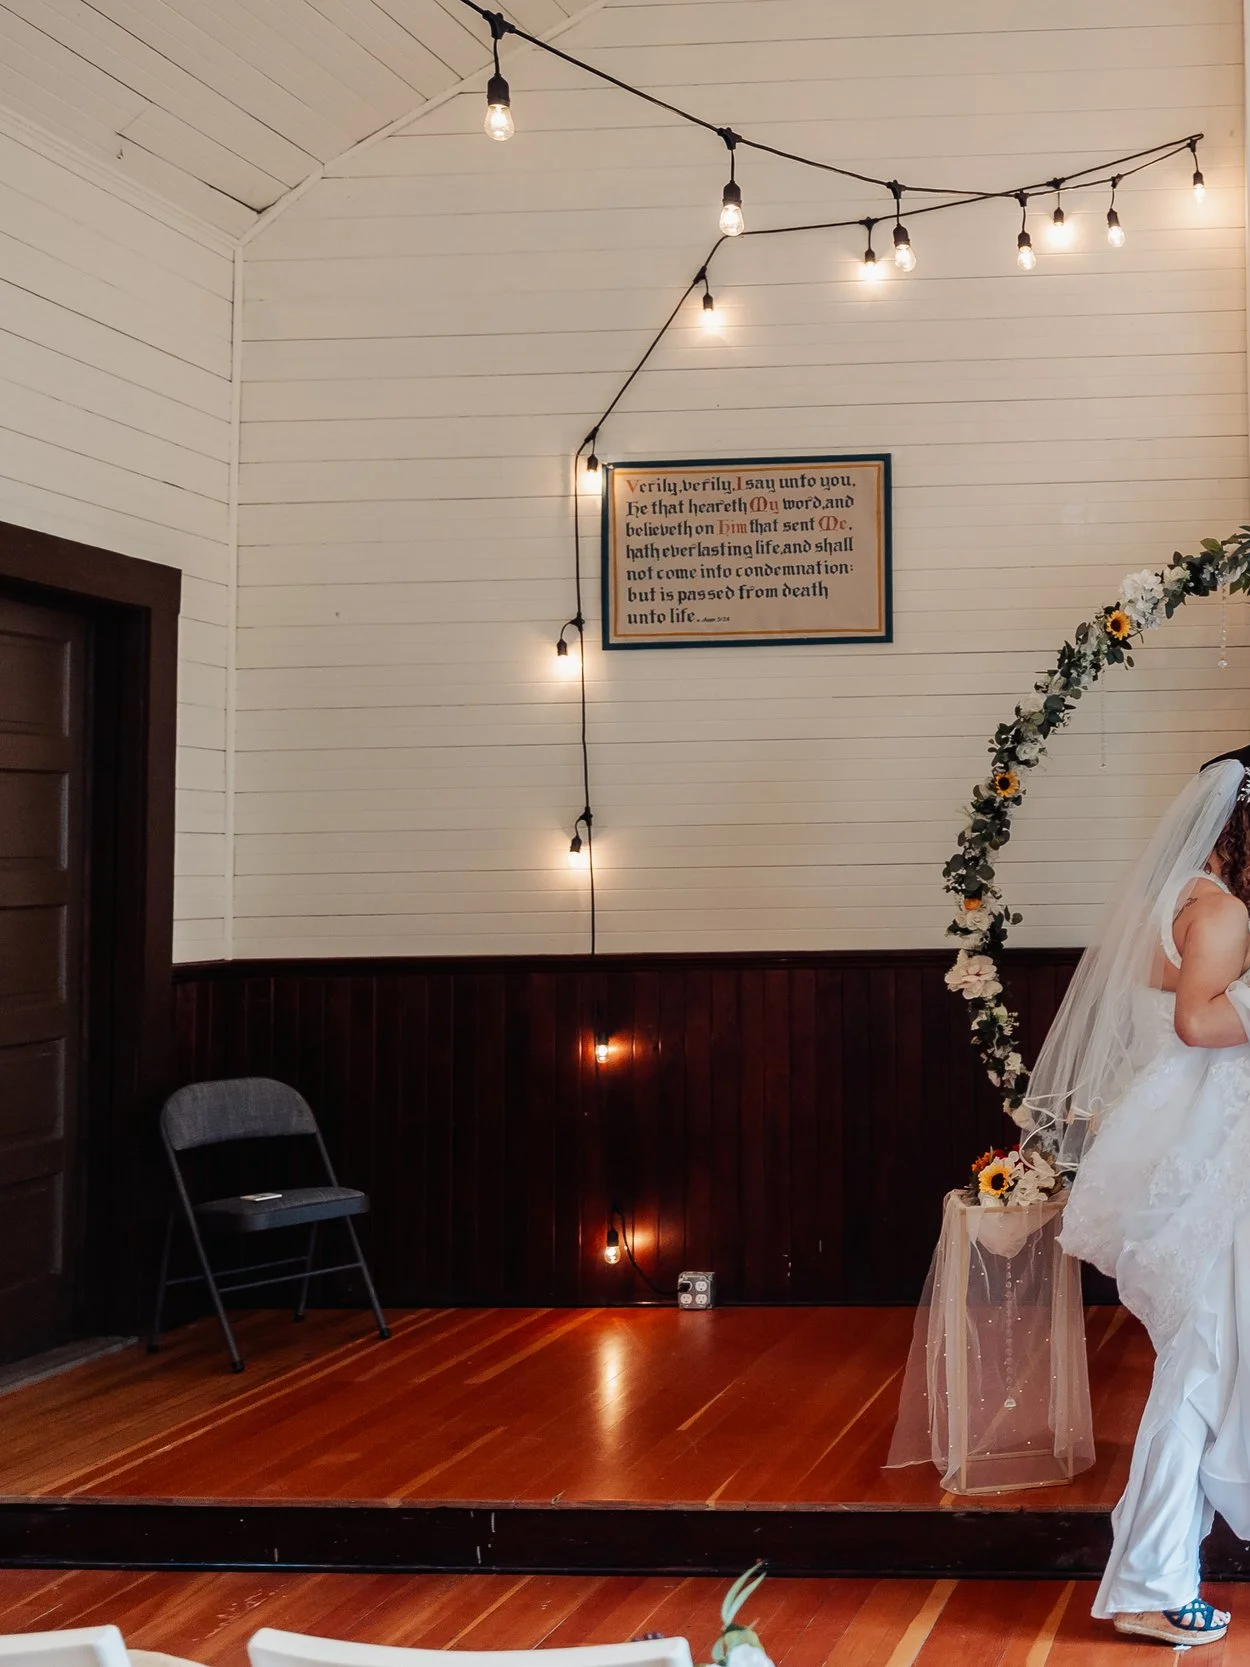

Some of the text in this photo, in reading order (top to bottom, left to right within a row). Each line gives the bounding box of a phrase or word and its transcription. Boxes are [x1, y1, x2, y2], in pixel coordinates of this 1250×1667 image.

[736, 476, 743, 490] I
[746, 476, 776, 492] say
[779, 474, 816, 489] unto
[626, 501, 648, 517] He
[651, 500, 684, 518] that
[688, 499, 748, 516] heareth
[750, 496, 779, 514] My
[825, 494, 854, 509] and
[626, 522, 693, 538] believeth
[695, 522, 714, 534] on
[716, 519, 748, 537] Him
[749, 518, 778, 535] that
[783, 518, 816, 531] sent
[626, 543, 660, 562] hath
[784, 540, 811, 553] and
[815, 536, 854, 556] shall
[626, 560, 854, 580] not come into condemnation:
[628, 581, 828, 605] but is passed from death
[627, 610, 666, 624] unto
